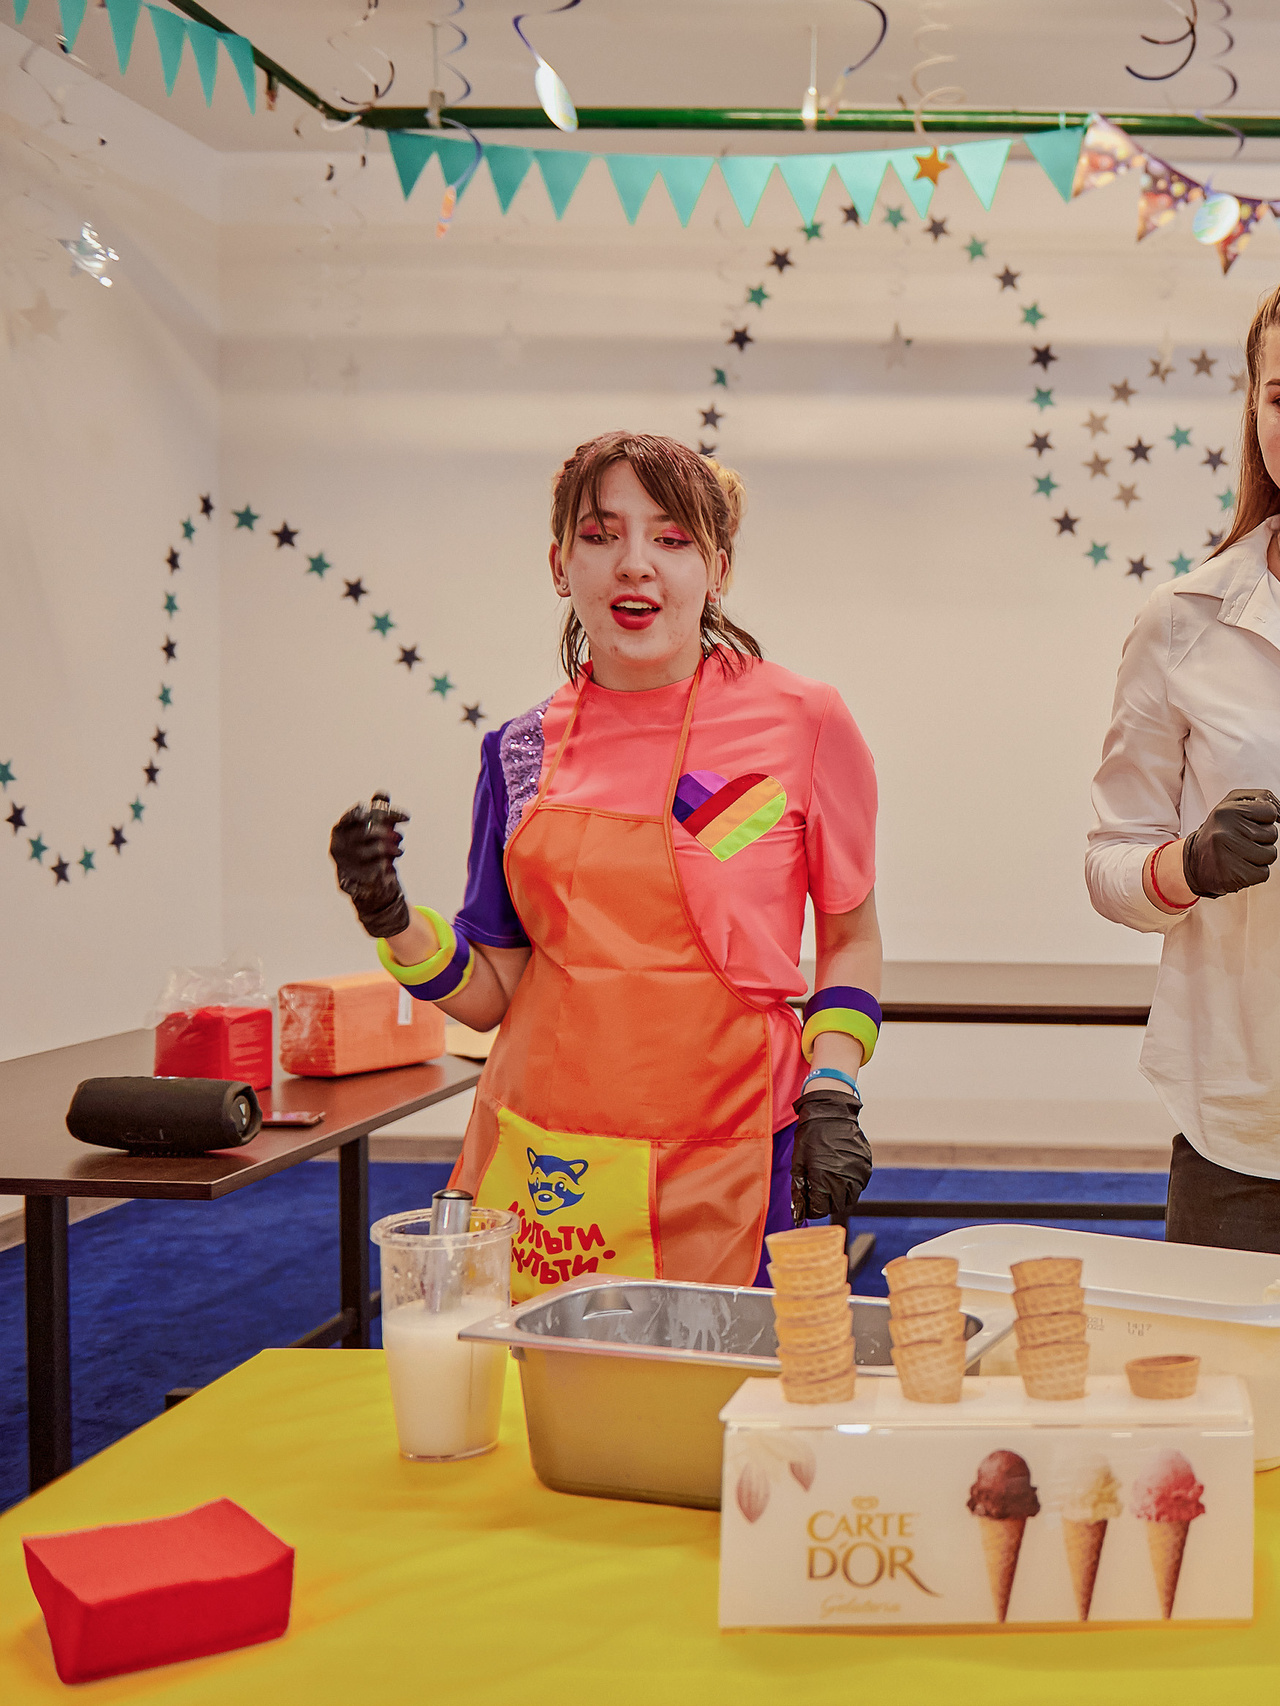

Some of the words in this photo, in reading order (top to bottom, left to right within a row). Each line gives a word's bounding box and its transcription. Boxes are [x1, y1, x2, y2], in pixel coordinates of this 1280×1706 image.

[510, 1237, 600, 1285] УЛЬТИ
[806, 1510, 921, 1543] CARTE
[806, 1541, 944, 1598] D'OR
